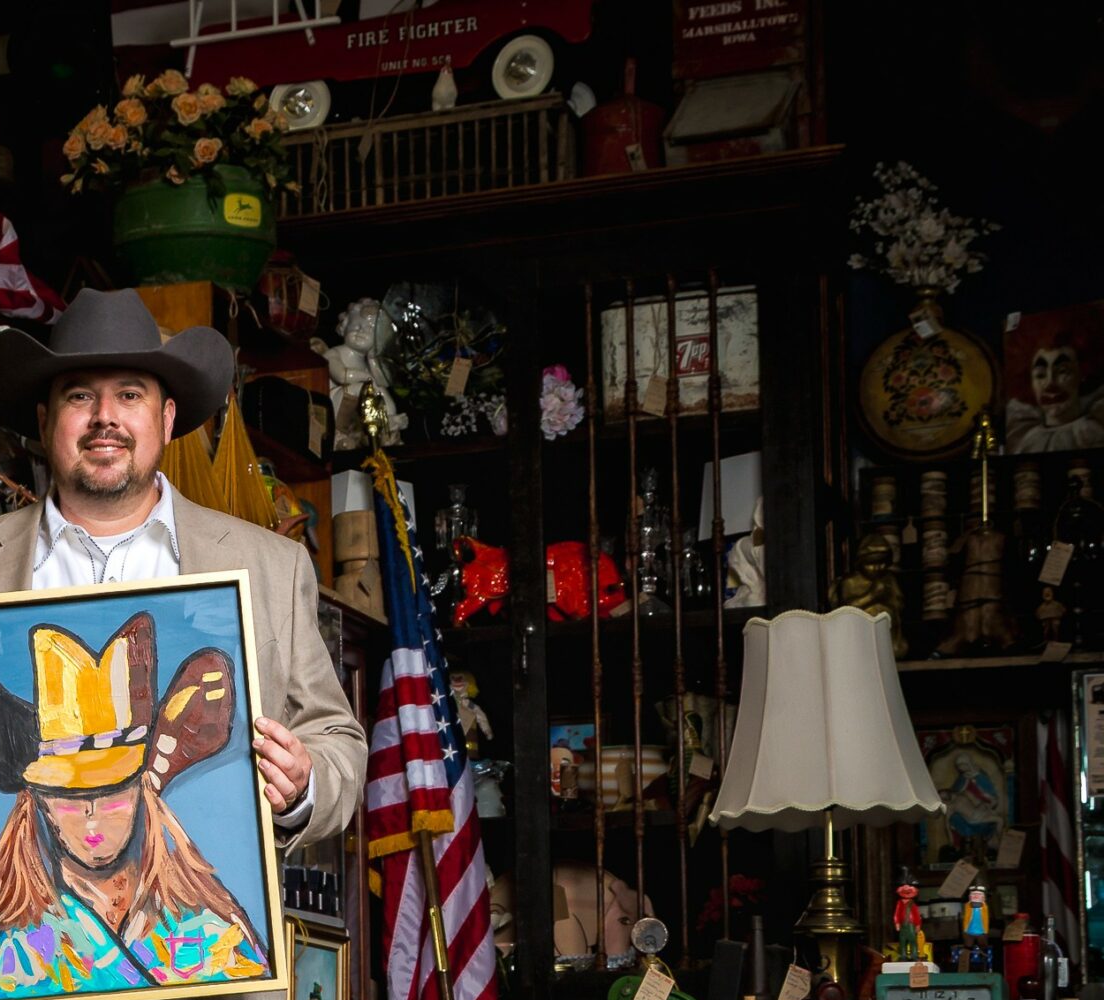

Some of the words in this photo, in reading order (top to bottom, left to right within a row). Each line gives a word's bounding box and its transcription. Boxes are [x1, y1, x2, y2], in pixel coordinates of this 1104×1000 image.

[346, 28, 390, 49] FIRE
[399, 16, 478, 41] FIGHTER
[722, 32, 756, 46] IOWA
[934, 991, 945, 999] 12
